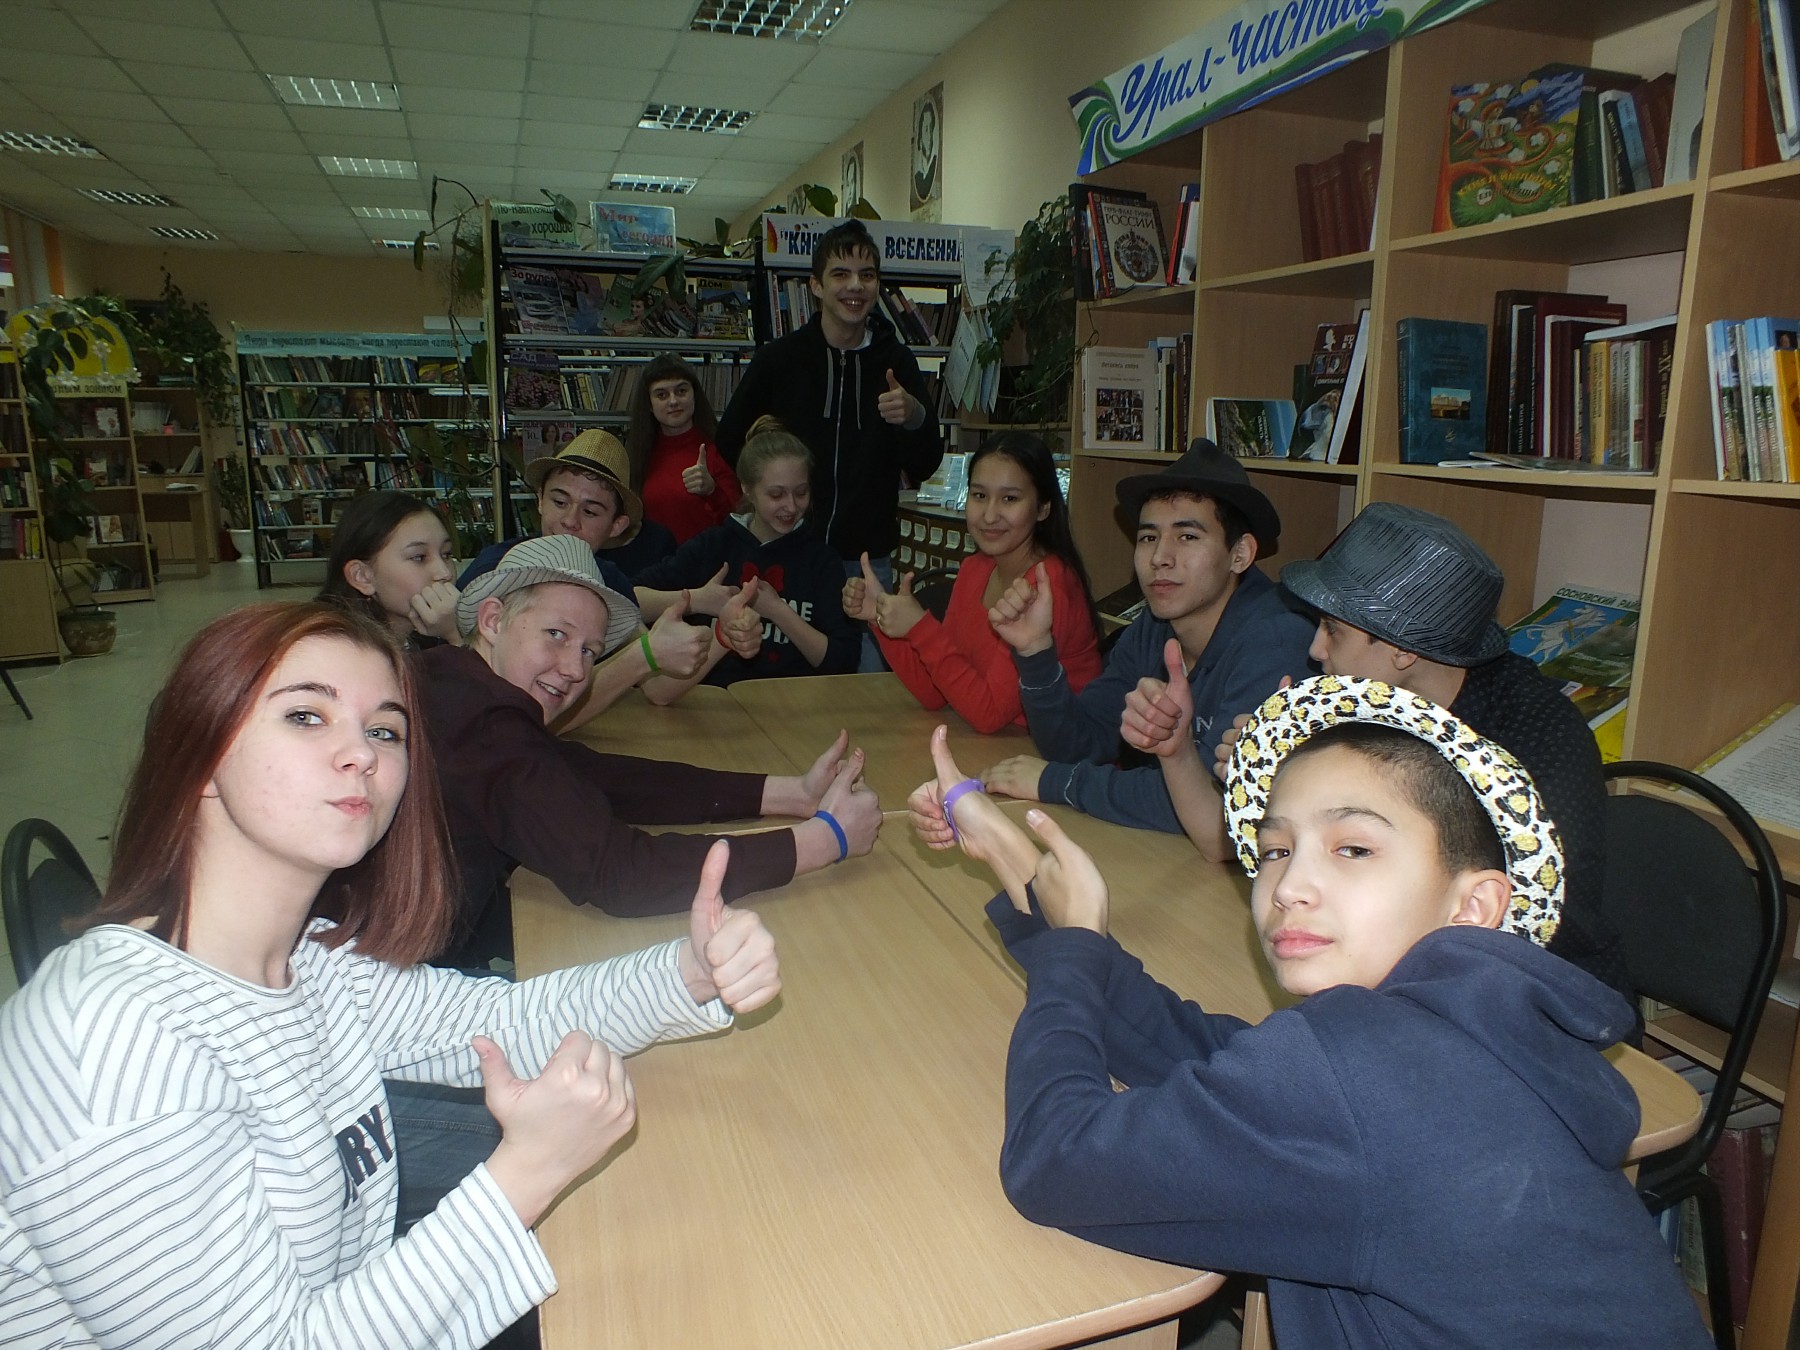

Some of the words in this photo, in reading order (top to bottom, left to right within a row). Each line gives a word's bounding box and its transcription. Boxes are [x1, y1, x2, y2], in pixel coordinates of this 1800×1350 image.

[1105, 213, 1155, 230] РОССИИ
[885, 236, 960, 262] ВСЕЛЕНН
[1556, 587, 1616, 607] СОСНОВСКИЙ
